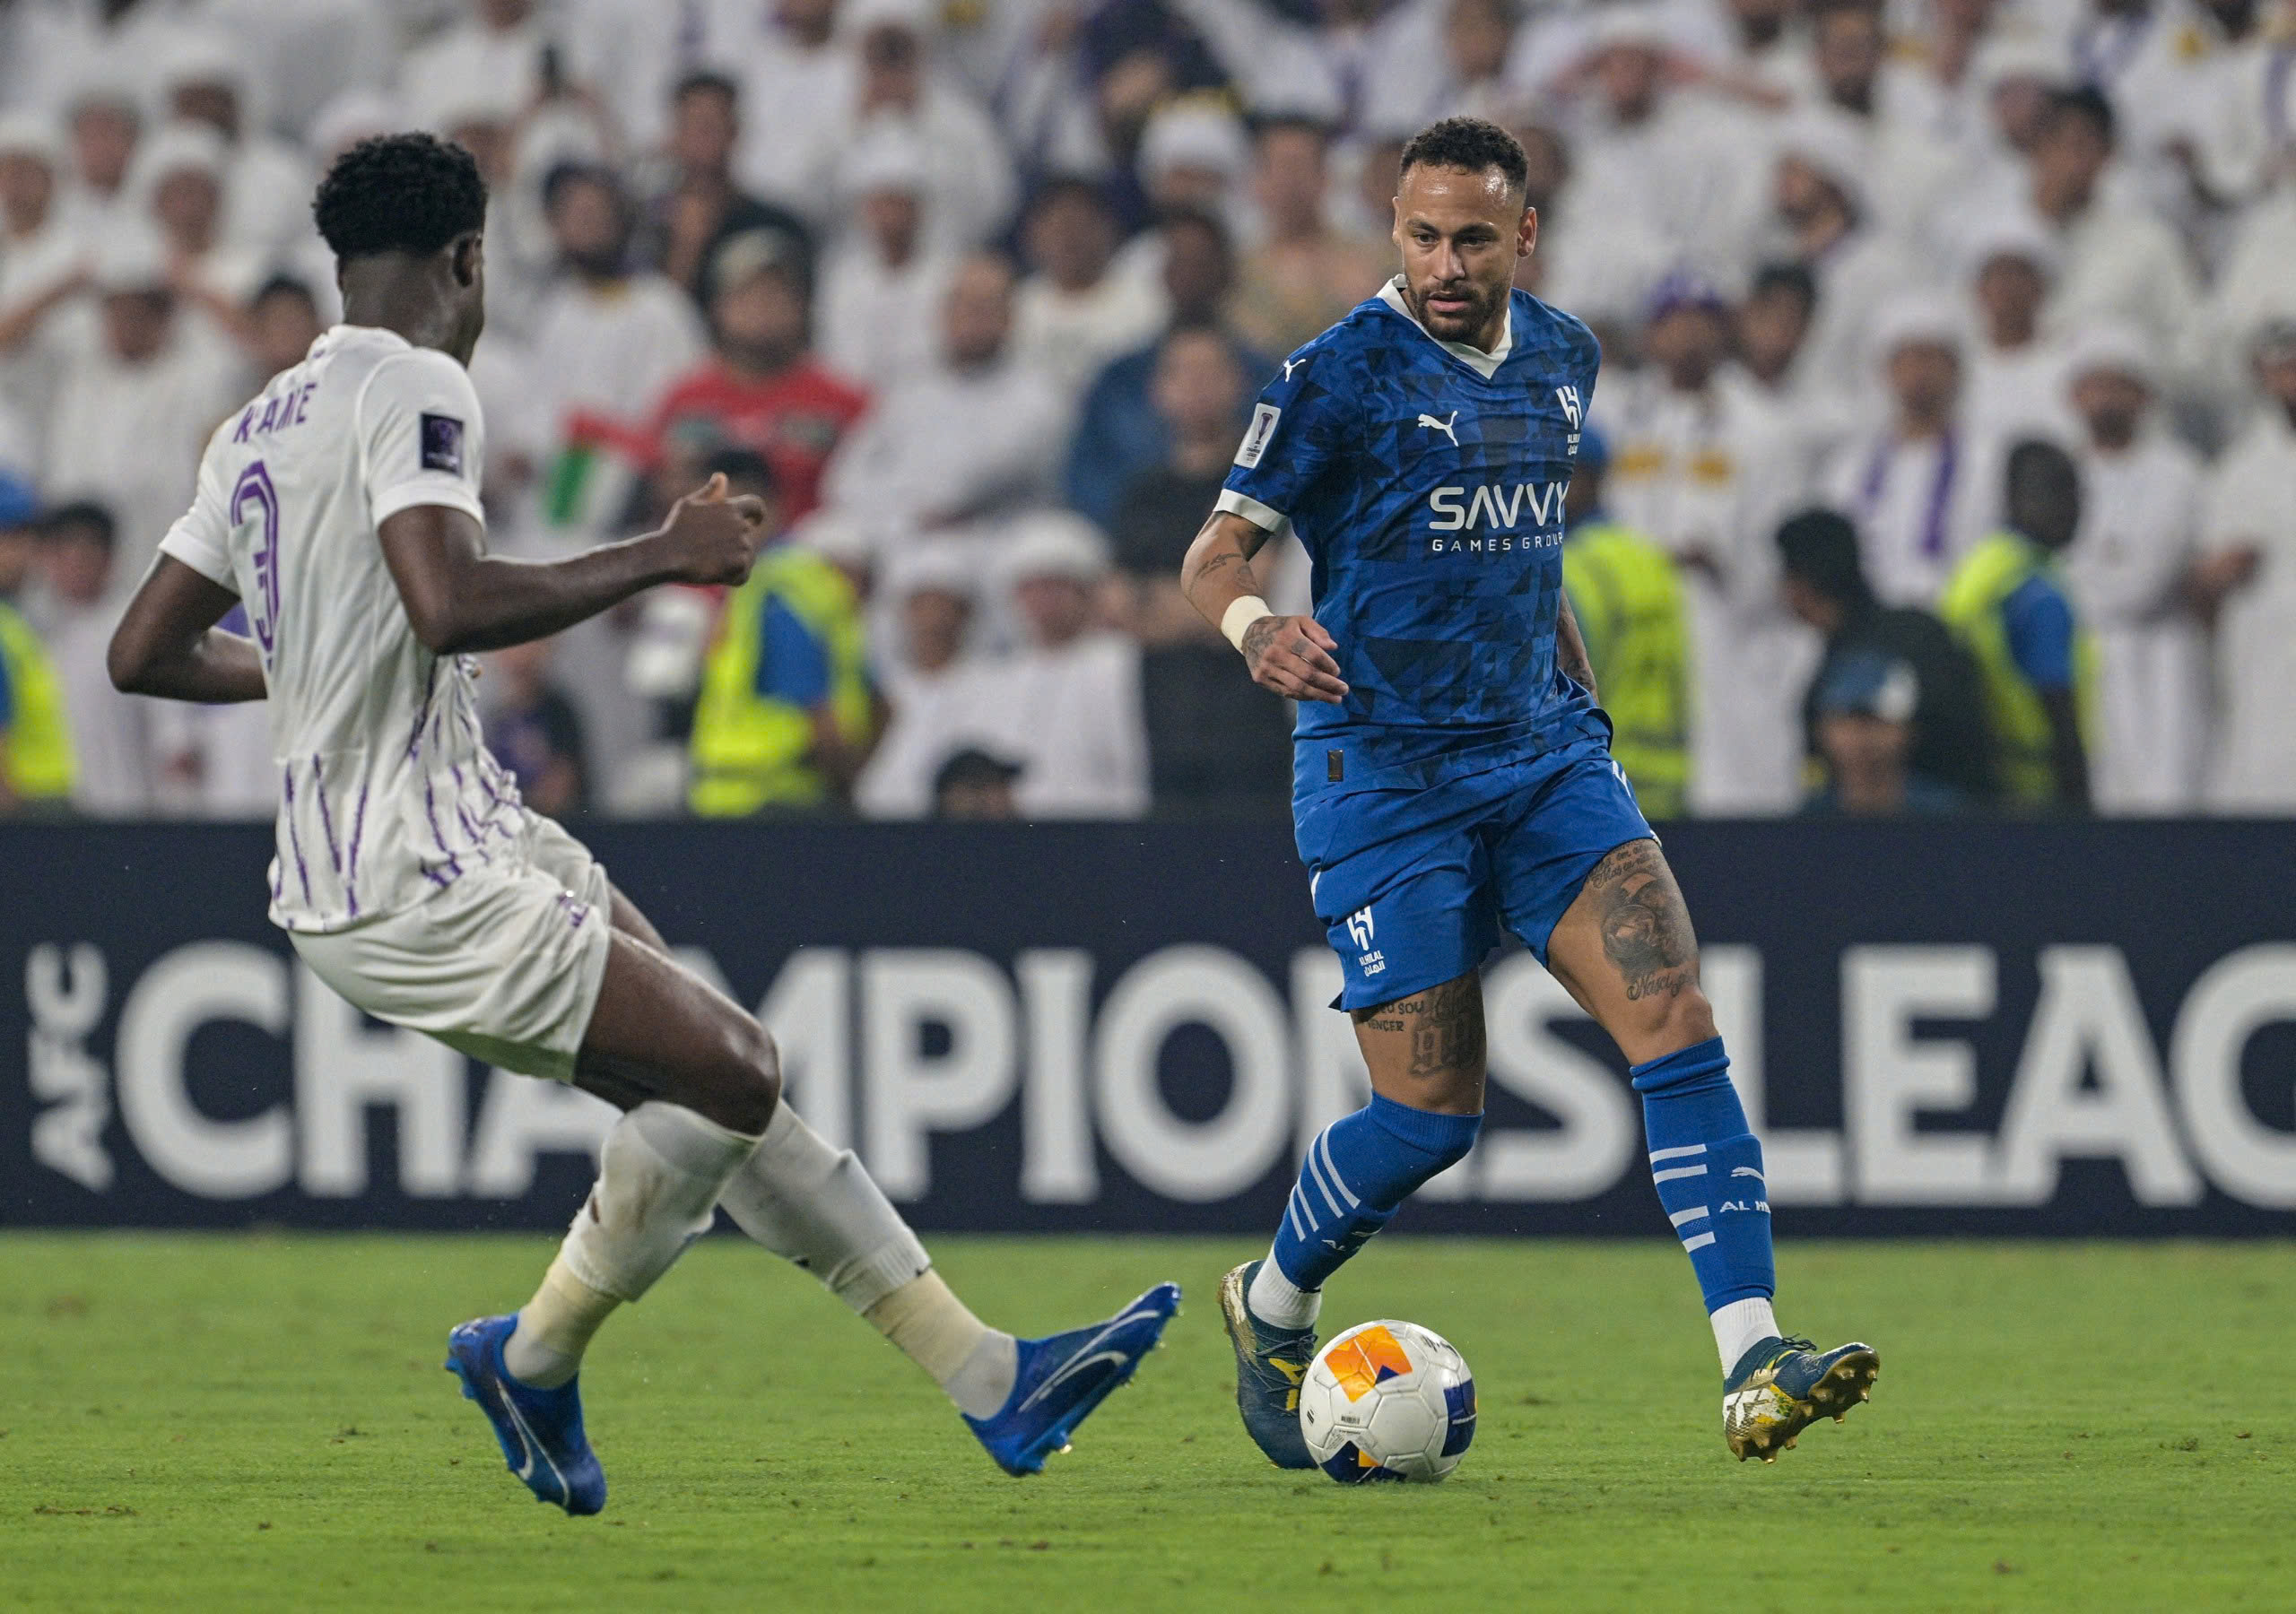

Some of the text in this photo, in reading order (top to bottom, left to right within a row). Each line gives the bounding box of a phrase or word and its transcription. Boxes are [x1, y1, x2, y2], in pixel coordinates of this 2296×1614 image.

[1429, 481, 1570, 531] SAVVY
[230, 459, 280, 653] 3
[1432, 532, 1563, 551] GAMES GROUP
[24, 938, 117, 1196] AFC
[1719, 1200, 1752, 1213] AL
